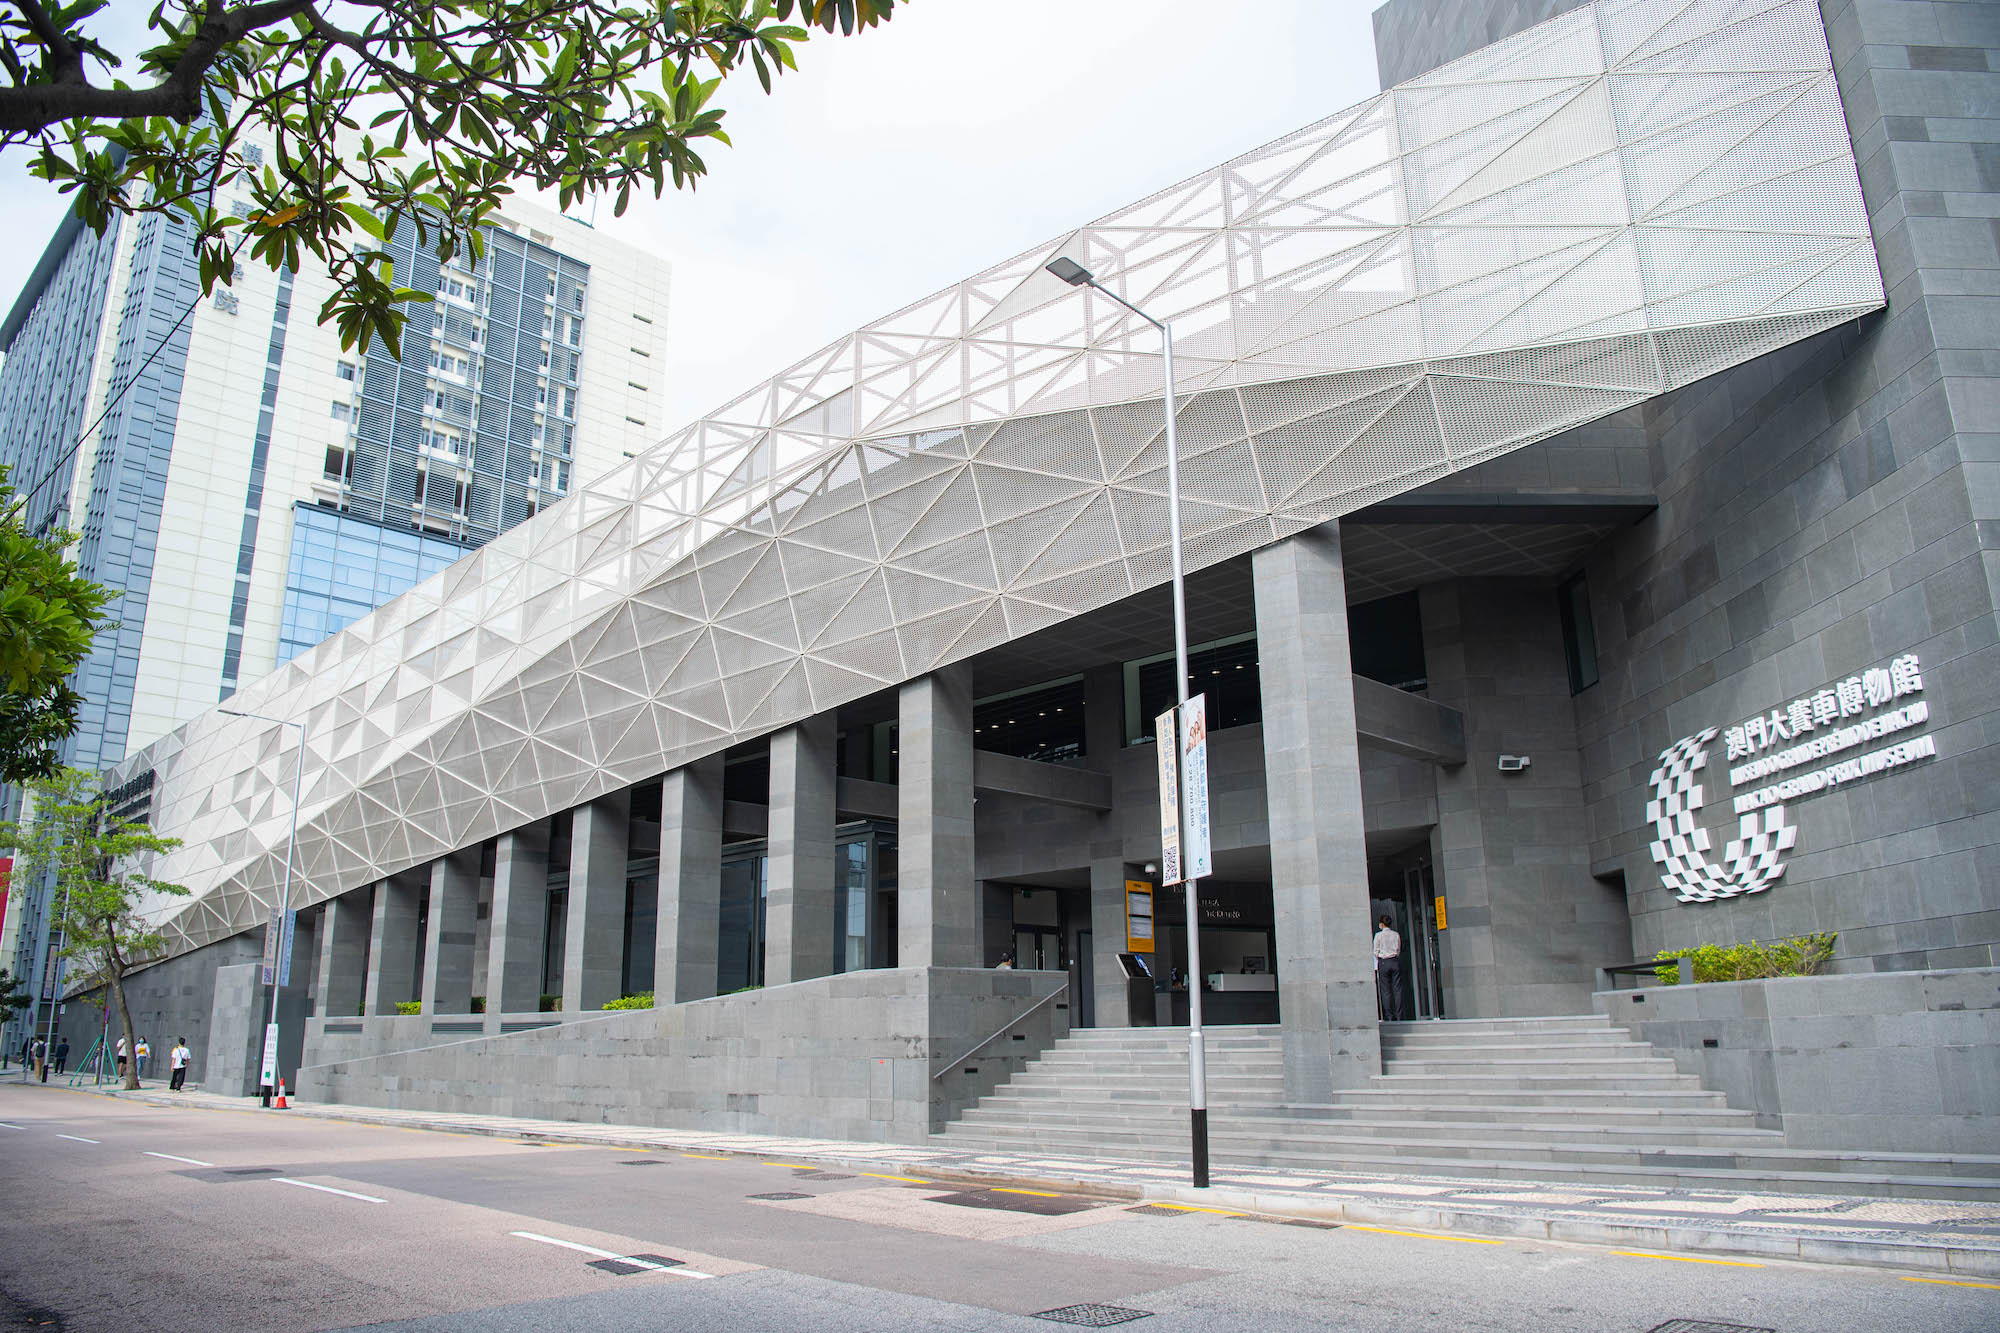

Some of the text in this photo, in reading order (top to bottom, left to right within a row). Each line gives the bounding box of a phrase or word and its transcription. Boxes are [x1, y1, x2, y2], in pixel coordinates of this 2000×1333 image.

[1725, 654, 1924, 761] 澳門大賽車博物館
